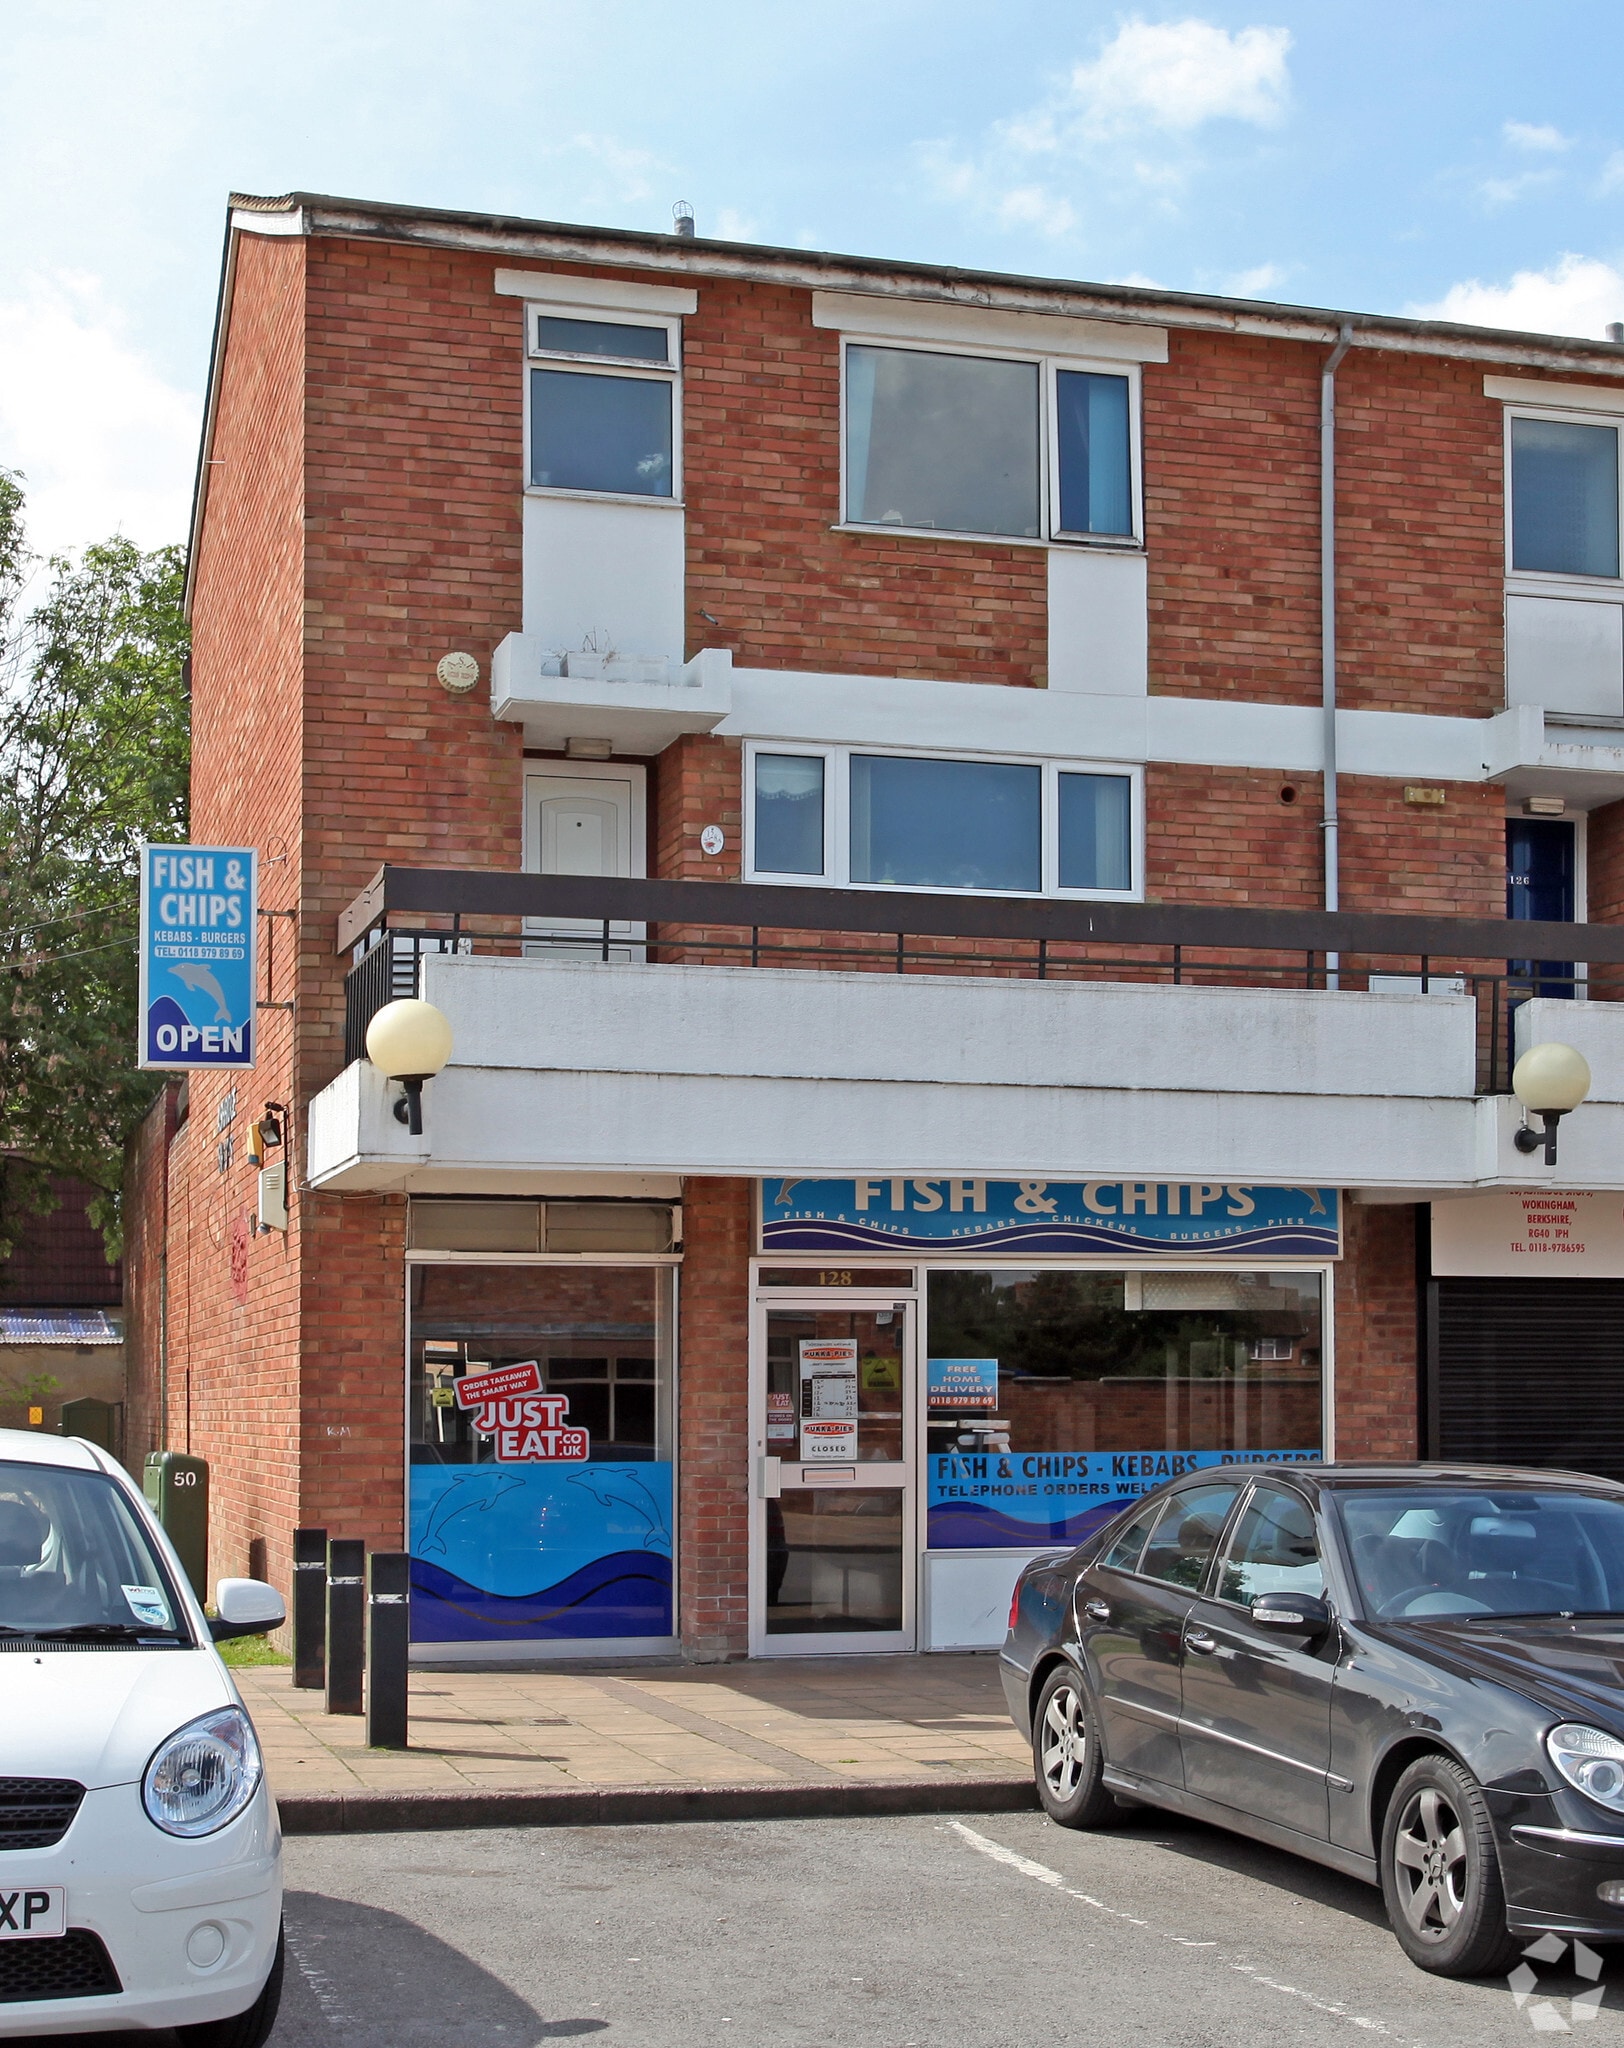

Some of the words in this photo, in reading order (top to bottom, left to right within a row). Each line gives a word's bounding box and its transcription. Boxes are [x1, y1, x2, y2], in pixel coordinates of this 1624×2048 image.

[153, 855, 214, 890] FISH
[224, 858, 247, 891] &
[1510, 876, 1530, 885] 126
[160, 893, 242, 927] CHIPS
[154, 930, 192, 942] KEBABS
[201, 932, 246, 944] BURGERS
[156, 947, 176, 956] TEL:
[178, 947, 198, 957] 0118
[201, 948, 216, 958] 979
[219, 949, 229, 958] 89
[232, 949, 242, 958] 69
[156, 1024, 244, 1053] OPEN
[854, 1178, 987, 1212] FISH
[1013, 1180, 1058, 1214] &
[1082, 1182, 1256, 1217] CHIPS
[1522, 1200, 1578, 1212] WOKINGHAM,
[784, 1211, 826, 1219] FISH
[837, 1213, 846, 1222] &
[858, 1217, 910, 1235] CHIPS
[952, 1218, 1017, 1237] KEBABS
[1051, 1214, 1138, 1234] CHICKENS
[1170, 1225, 1243, 1240] BURGERS
[1268, 1218, 1304, 1226] PIES
[1527, 1215, 1572, 1226] BERKSHIRE,
[1528, 1229, 1550, 1238] RG40
[1555, 1229, 1569, 1238] 1PH
[1510, 1243, 1526, 1252] TEL.
[1529, 1243, 1585, 1252] 0118-9786595
[818, 1271, 852, 1286] 128
[462, 1380, 489, 1391] ORDER
[490, 1369, 532, 1385] TAKEAWAY
[466, 1390, 481, 1400] THE
[482, 1384, 508, 1396] SMART
[510, 1380, 528, 1390] WAY
[930, 1396, 951, 1404] 0118
[952, 1396, 968, 1404] 979
[480, 1401, 562, 1428] JUST
[502, 1430, 562, 1457] EAT
[938, 1456, 987, 1479] FISH
[997, 1456, 1013, 1478] &
[1023, 1456, 1088, 1478] CHIPS
[1112, 1454, 1198, 1477] KEBABS
[174, 1472, 196, 1487] 50
[938, 1484, 1037, 1496] TELEPHONE
[1044, 1483, 1110, 1495] ORDERS
[0, 1892, 50, 1930] XP
